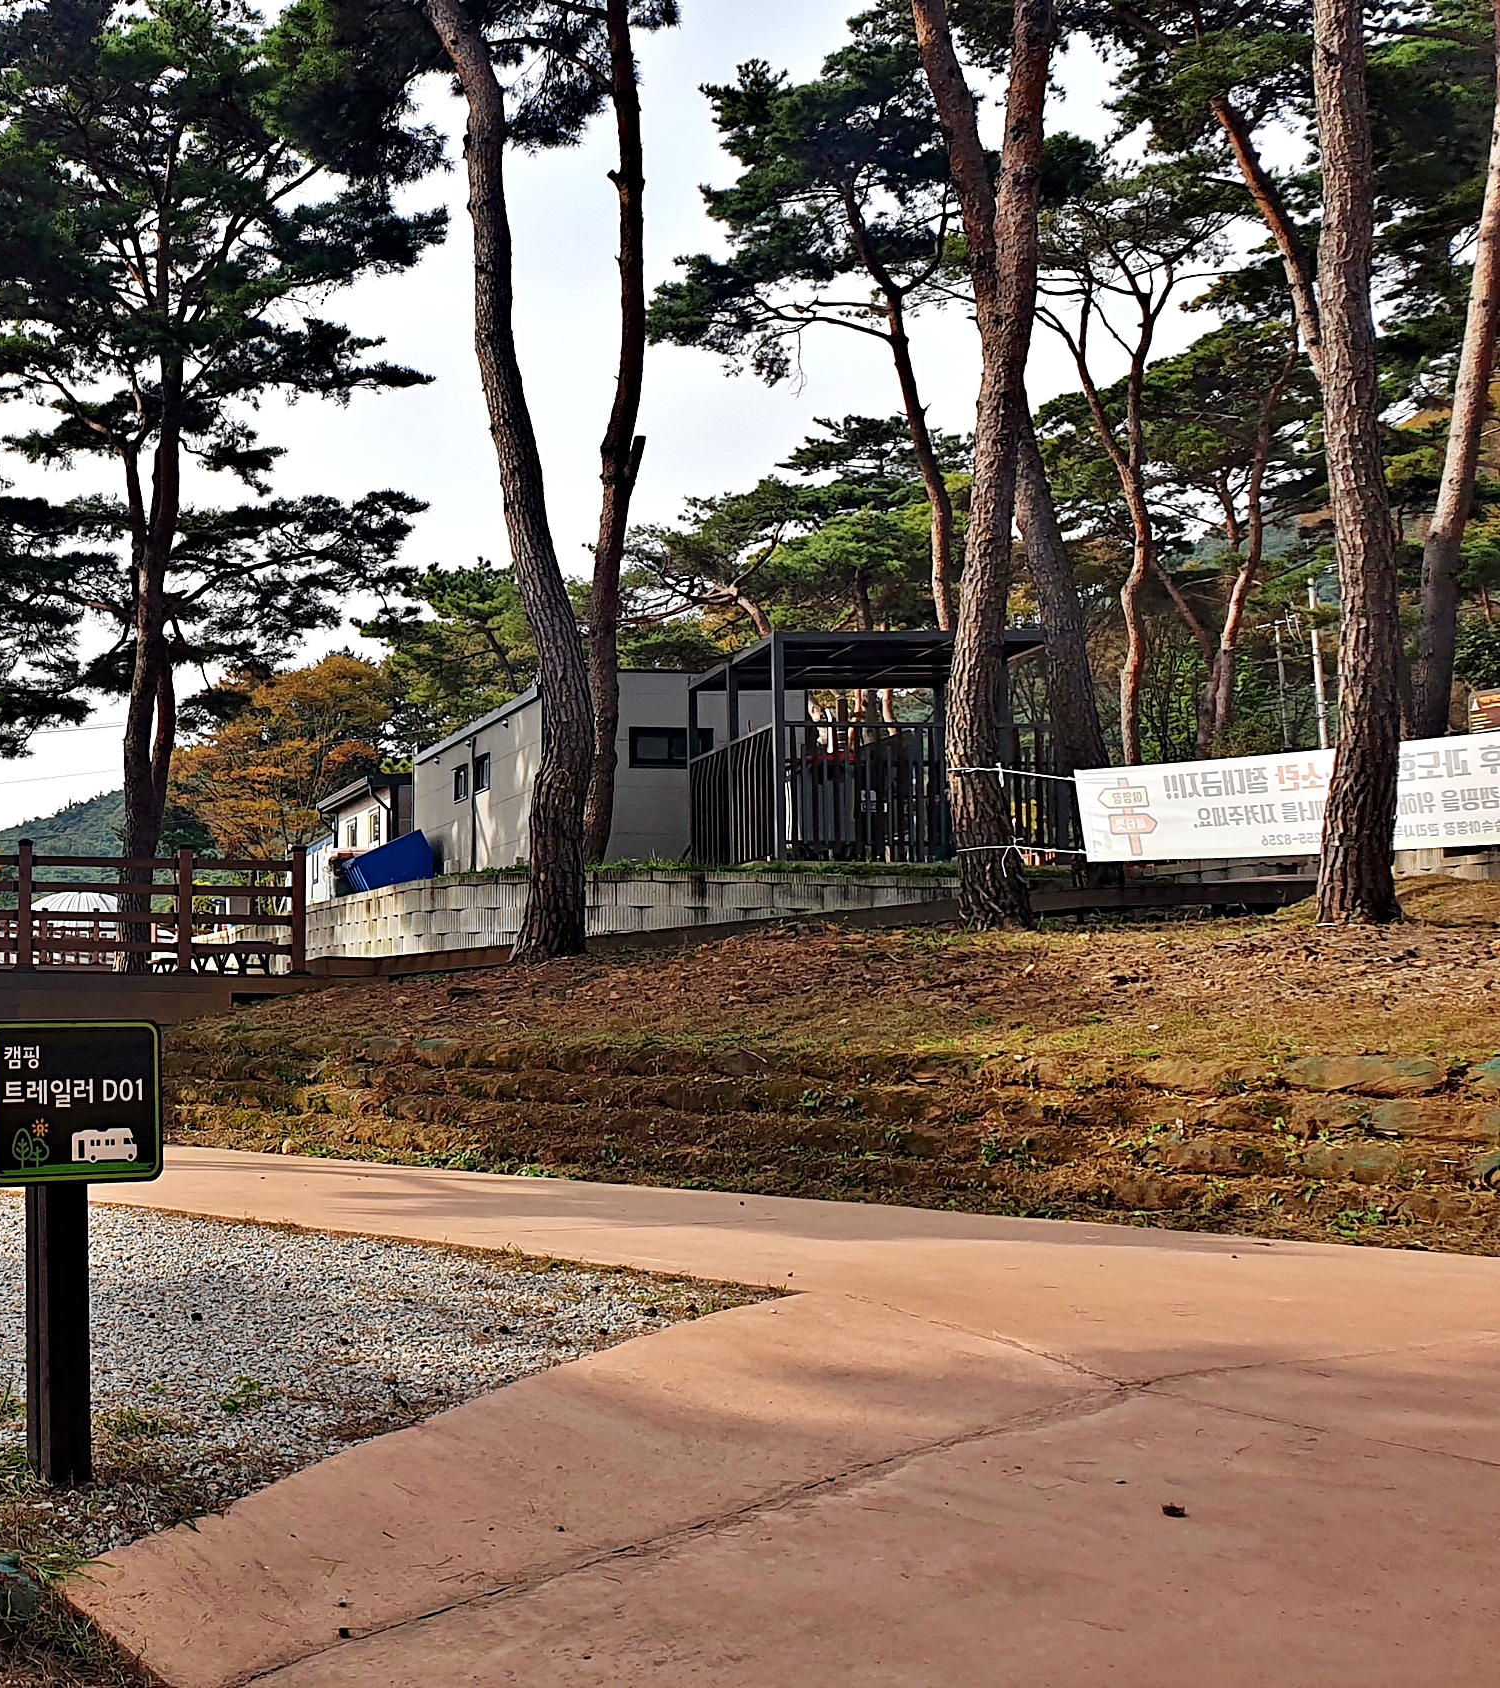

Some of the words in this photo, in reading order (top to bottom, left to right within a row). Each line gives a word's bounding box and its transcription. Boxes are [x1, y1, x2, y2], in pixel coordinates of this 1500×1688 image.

[3, 1045, 40, 1070] 캠핑
[2, 1078, 94, 1108] 트레일러
[102, 1078, 143, 1102] D01
